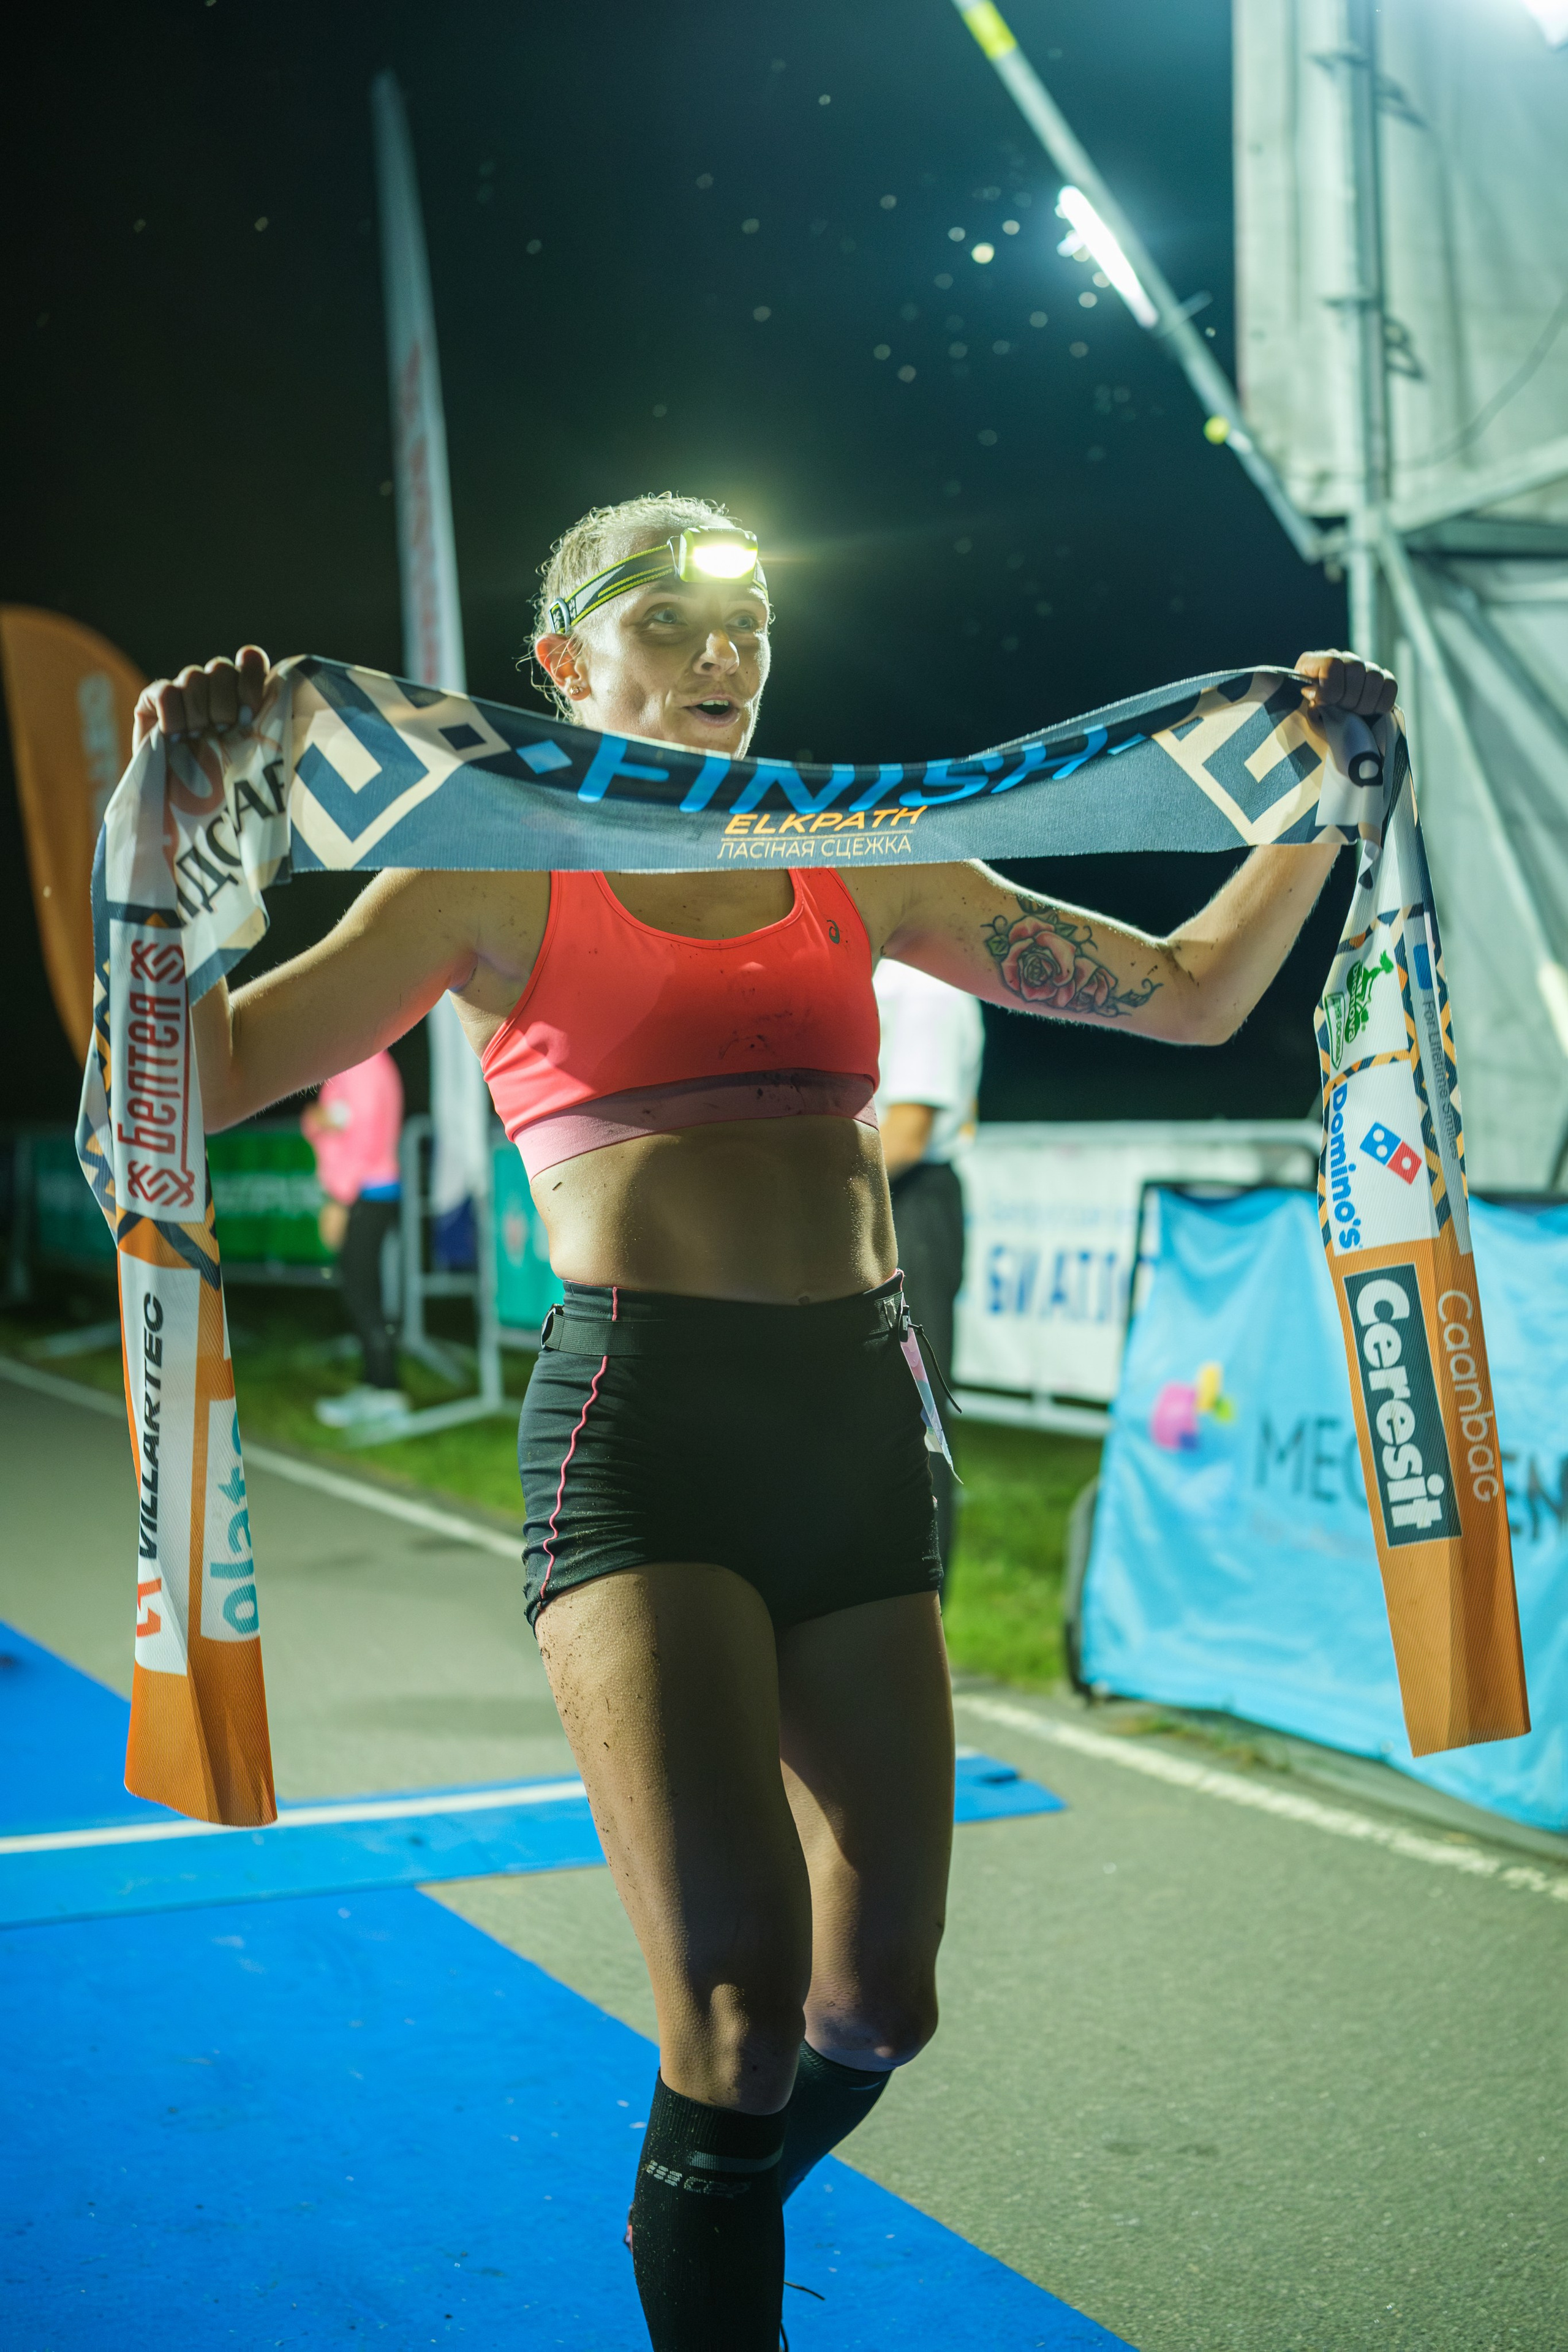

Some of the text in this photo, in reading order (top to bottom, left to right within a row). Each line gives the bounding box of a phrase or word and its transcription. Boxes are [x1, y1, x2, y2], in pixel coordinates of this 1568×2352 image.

[577, 724, 1108, 813] FINISH
[717, 835, 912, 859] ЛАСІНАЯ СЦЕЖКА
[724, 805, 928, 835] ELKPATH
[1423, 1000, 1438, 1027] For
[1442, 1102, 1458, 1161] Smiles
[1330, 1083, 1362, 1250] Domino's
[139, 1293, 164, 1559] VILLARTEC
[1356, 1278, 1445, 1529] Ceresit
